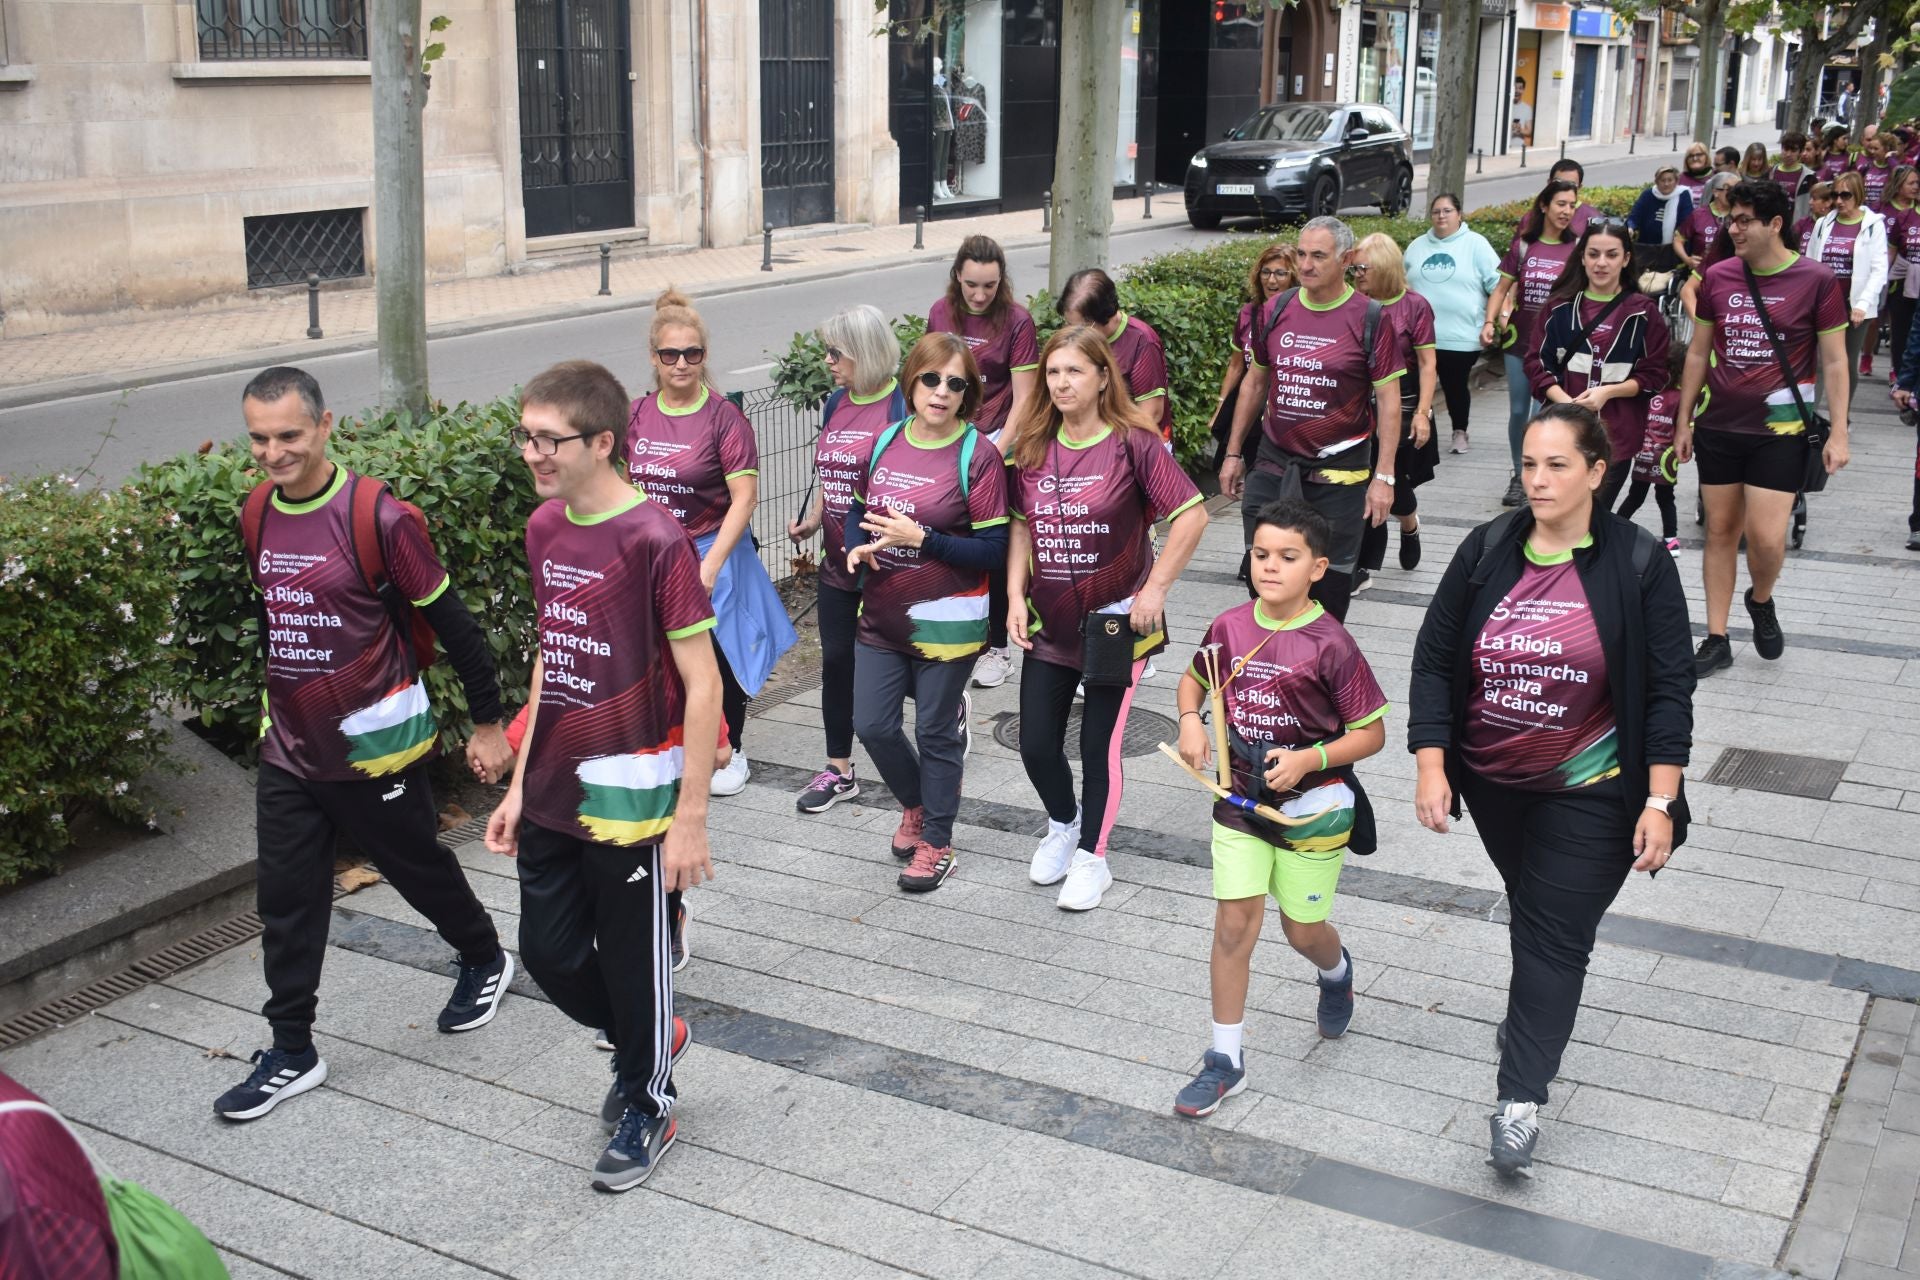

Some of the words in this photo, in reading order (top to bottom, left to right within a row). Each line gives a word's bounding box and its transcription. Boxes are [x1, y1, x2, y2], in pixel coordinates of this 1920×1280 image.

[1725, 314, 1740, 324] La
[1724, 327, 1738, 336] En
[1276, 354, 1290, 366] La
[1293, 356, 1322, 371] Rioja
[1292, 375, 1337, 388] marcha
[1278, 384, 1310, 396] contra
[1286, 394, 1327, 410] cáncer
[818, 450, 830, 462] La
[832, 452, 856, 466] Rioja
[630, 462, 642, 474] La
[646, 464, 676, 478] Rioja
[819, 466, 832, 478] En
[834, 470, 860, 480] marc
[648, 482, 694, 494] marcha
[822, 481, 852, 492] ontra
[866, 492, 878, 506] La
[882, 496, 914, 514] Rioja
[1034, 502, 1052, 514] La
[1036, 521, 1054, 534] En
[1038, 550, 1052, 562] el
[276, 586, 314, 606] Rioja
[1552, 600, 1584, 608] española
[266, 608, 276, 624] n
[280, 612, 342, 627] marcha
[270, 628, 308, 643] ontra
[1480, 632, 1504, 650] La
[1510, 634, 1562, 657] Rioja
[278, 644, 333, 662] cáncer
[1479, 657, 1504, 674] En
[1510, 664, 1588, 684] marcha
[1484, 677, 1542, 696] contra
[1248, 690, 1280, 709] Rioja
[1484, 688, 1499, 704] el
[1501, 694, 1568, 718] cáncer
[1234, 706, 1246, 720] En
